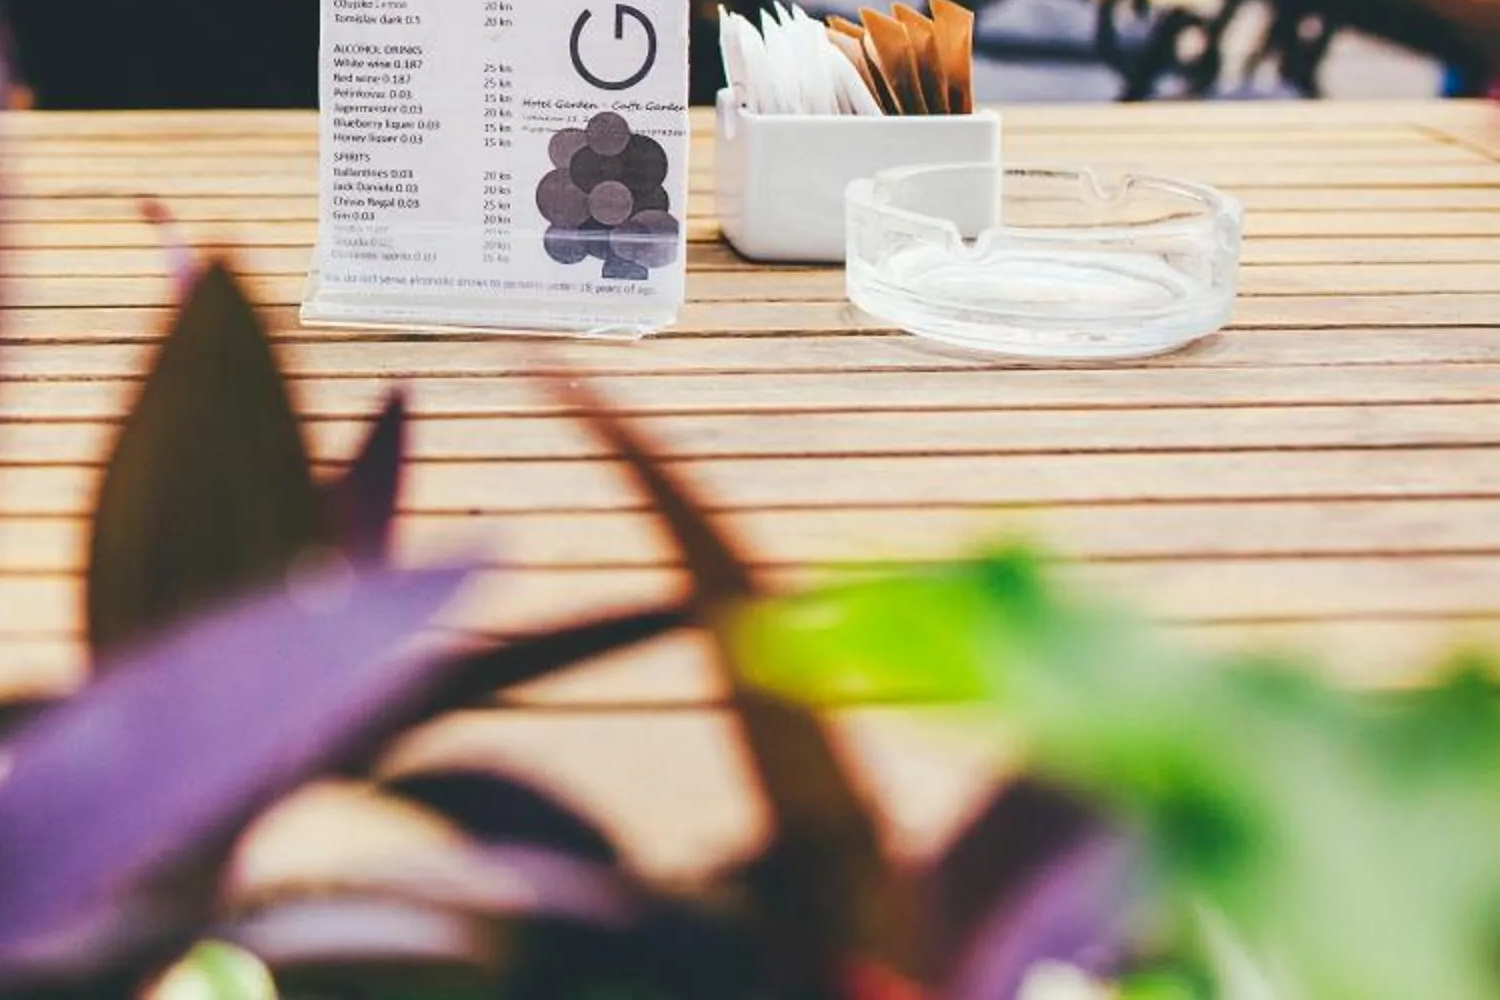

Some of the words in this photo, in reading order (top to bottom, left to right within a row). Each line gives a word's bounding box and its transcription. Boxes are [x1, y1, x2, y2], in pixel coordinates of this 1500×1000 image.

[484, 2, 496, 11] 20
[500, 2, 512, 11] kn
[380, 15, 402, 24] dark
[406, 15, 420, 25] 0.5
[484, 17, 496, 27] 20
[499, 17, 512, 27] kn
[384, 45, 423, 54] DRINKS
[334, 59, 364, 68] White
[367, 60, 390, 68] wine
[484, 64, 496, 73] 25
[499, 64, 511, 73] kn
[334, 74, 352, 83] Red
[484, 79, 496, 88] 25
[499, 78, 511, 88] kn
[484, 94, 496, 102] 15
[499, 93, 511, 102] kn
[523, 99, 550, 108] Hotel
[555, 99, 597, 110] Garden
[646, 102, 685, 111] Garden
[484, 108, 496, 117] 20
[499, 108, 511, 117] kn
[499, 123, 511, 132] kn
[499, 138, 511, 147] kn
[334, 152, 370, 162] SPIRITS
[483, 171, 496, 180] 20
[334, 182, 353, 191] Jack
[483, 186, 496, 195] 20
[483, 201, 496, 210] 25
[483, 215, 496, 224] 20
[624, 284, 635, 293] of
